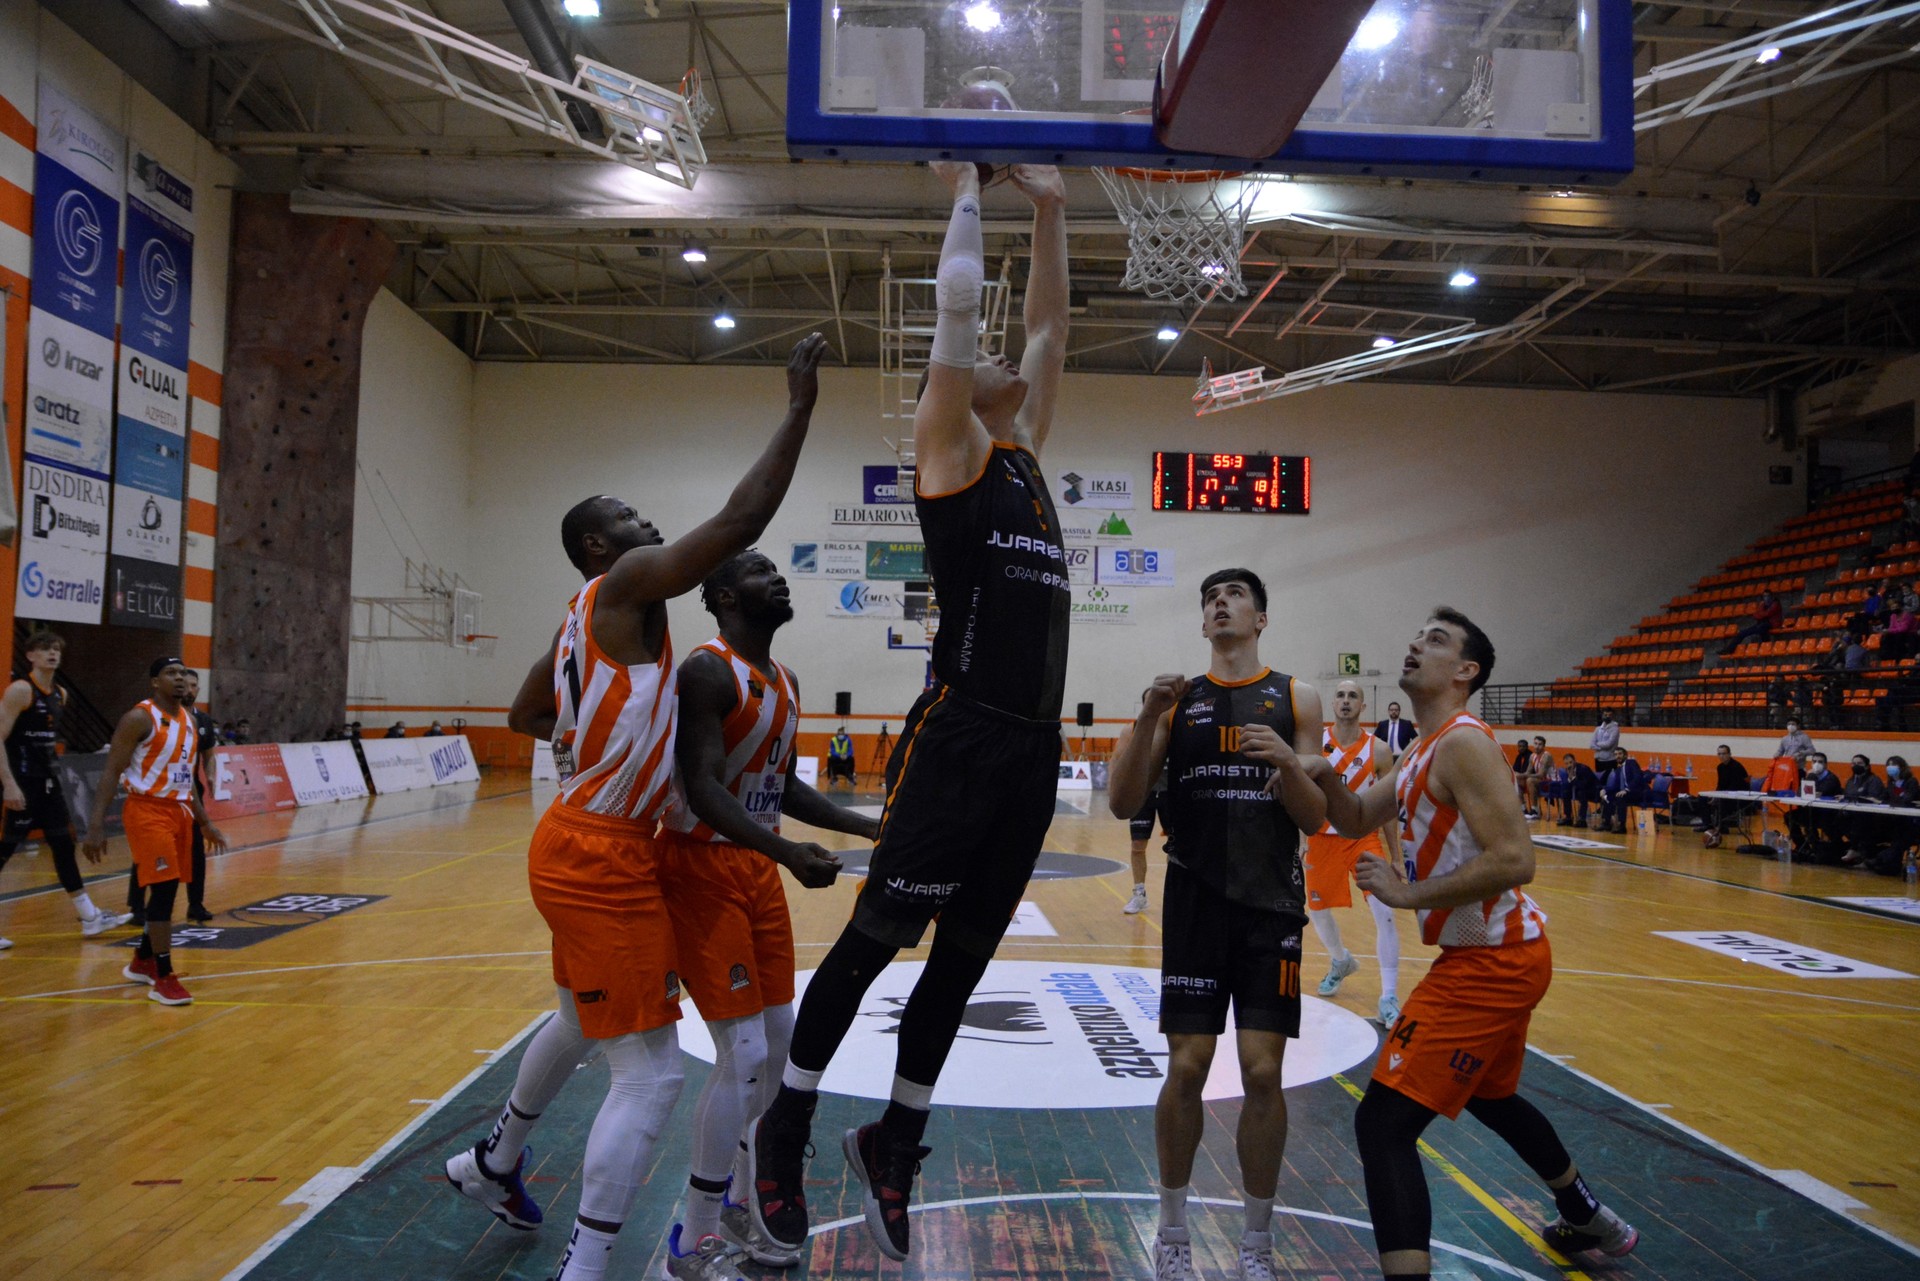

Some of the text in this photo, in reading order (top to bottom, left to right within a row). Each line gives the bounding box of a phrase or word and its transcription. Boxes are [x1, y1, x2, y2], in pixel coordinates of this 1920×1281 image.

[64, 350, 103, 381] irizar
[129, 357, 180, 400] GLUAL
[34, 395, 80, 425] aratz
[1213, 454, 1243, 468] 55:3
[29, 466, 105, 507] DISDIRA
[1091, 480, 1127, 492] IKASI
[1205, 478, 1218, 490] 17
[1254, 480, 1267, 492] 18
[1199, 494, 1207, 504] 5
[1255, 496, 1263, 505] 4
[57, 512, 100, 539] Bitxitegia
[834, 509, 849, 521] EL
[852, 509, 898, 522] DIARIO
[824, 543, 846, 551] ERLO
[46, 577, 101, 605] sarralle
[127, 590, 175, 617] ELIKU
[1072, 603, 1129, 614] ZARRAITZ
[1218, 726, 1241, 753] 10
[430, 739, 470, 781] INSALUS
[1278, 959, 1300, 1001] 10
